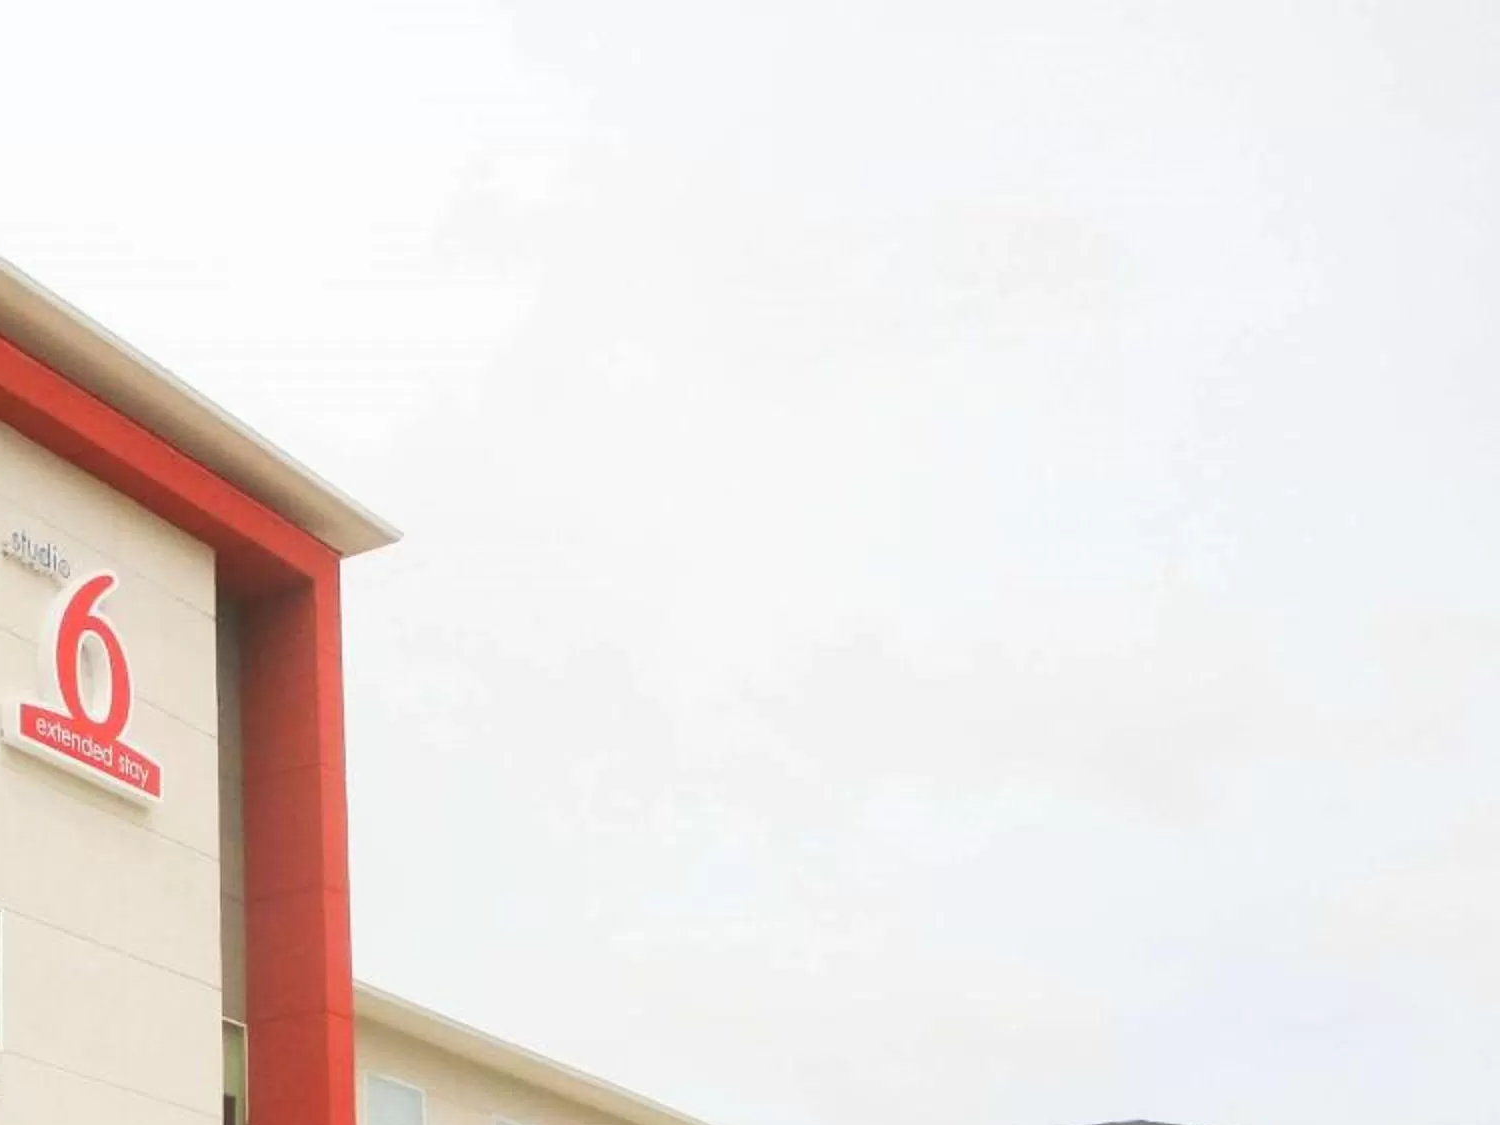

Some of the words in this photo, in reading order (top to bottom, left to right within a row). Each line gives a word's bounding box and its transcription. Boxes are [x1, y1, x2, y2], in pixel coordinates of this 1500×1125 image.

[10, 530, 71, 579] studio
[55, 574, 131, 742] 6
[35, 716, 113, 767] extended
[118, 753, 149, 787] stay
